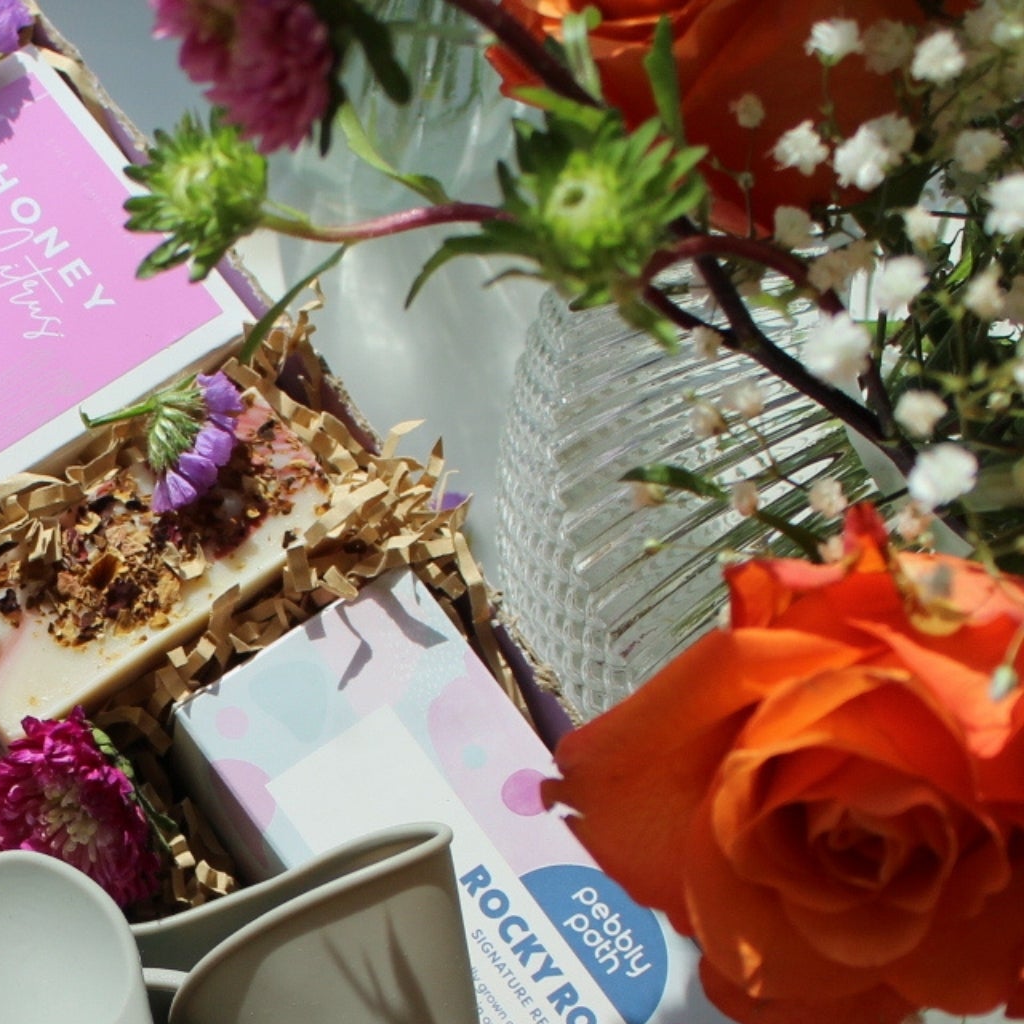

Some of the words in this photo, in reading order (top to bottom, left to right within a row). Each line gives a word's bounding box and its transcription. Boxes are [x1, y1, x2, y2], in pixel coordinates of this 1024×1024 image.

[459, 864, 564, 983] ROCKY
[563, 913, 620, 975] path
[571, 886, 652, 978] pebbly
[472, 928, 534, 1009] SIGNATURE
[476, 983, 508, 1020] grown
